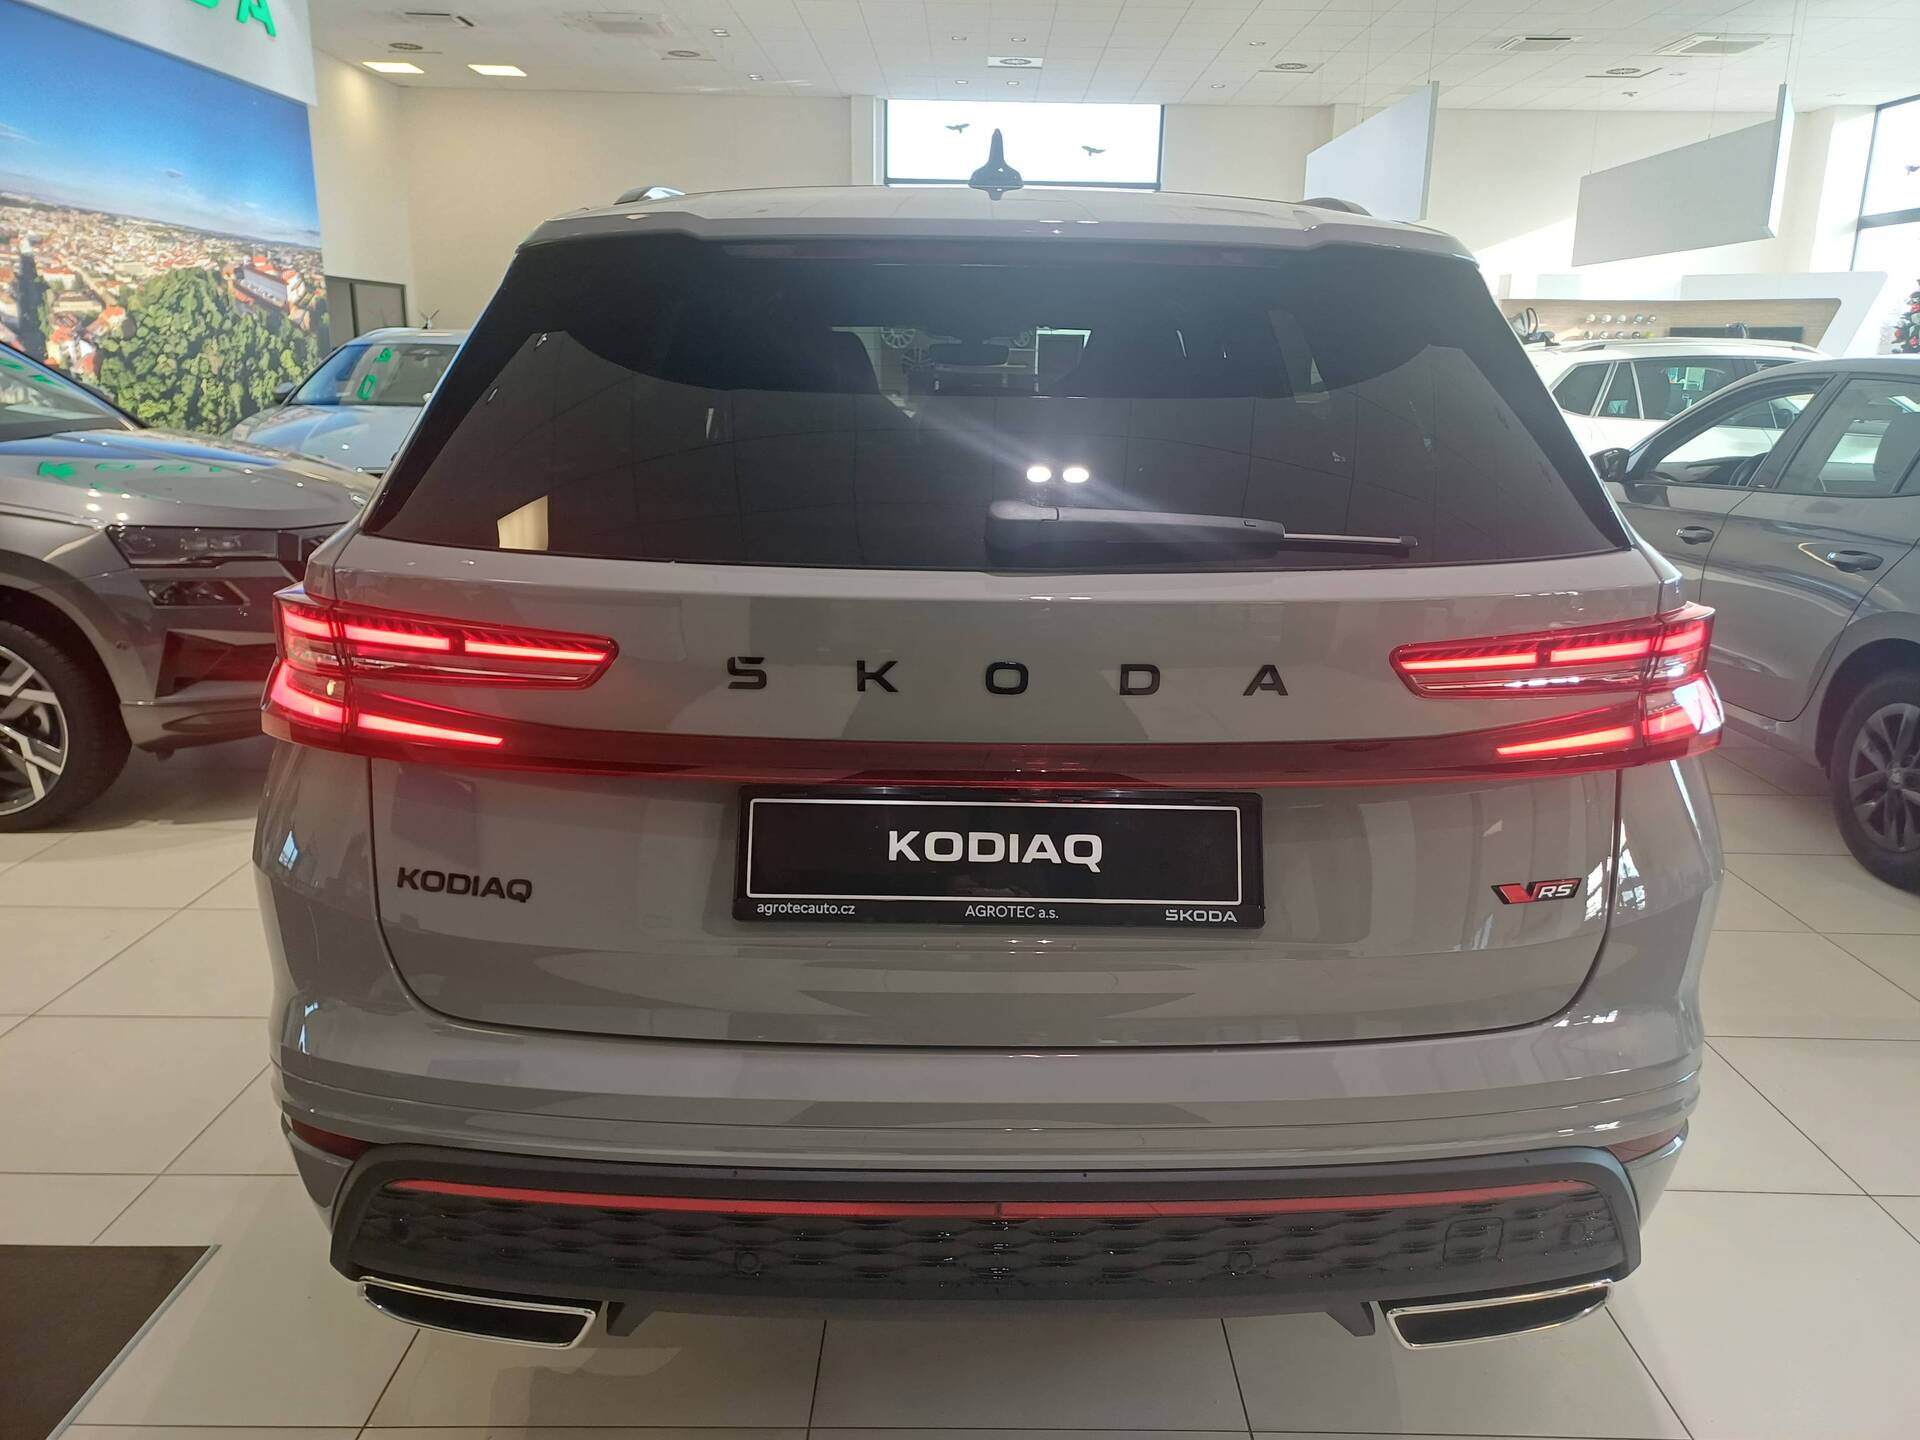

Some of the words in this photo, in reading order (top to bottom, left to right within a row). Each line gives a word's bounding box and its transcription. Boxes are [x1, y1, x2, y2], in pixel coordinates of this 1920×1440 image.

[888, 830, 1103, 873] KODIAQ
[397, 867, 533, 903] KODIAQ
[756, 902, 856, 915] agrotecauto.cz
[964, 904, 1036, 919] AGROTEC
[1038, 907, 1059, 919] a.s.
